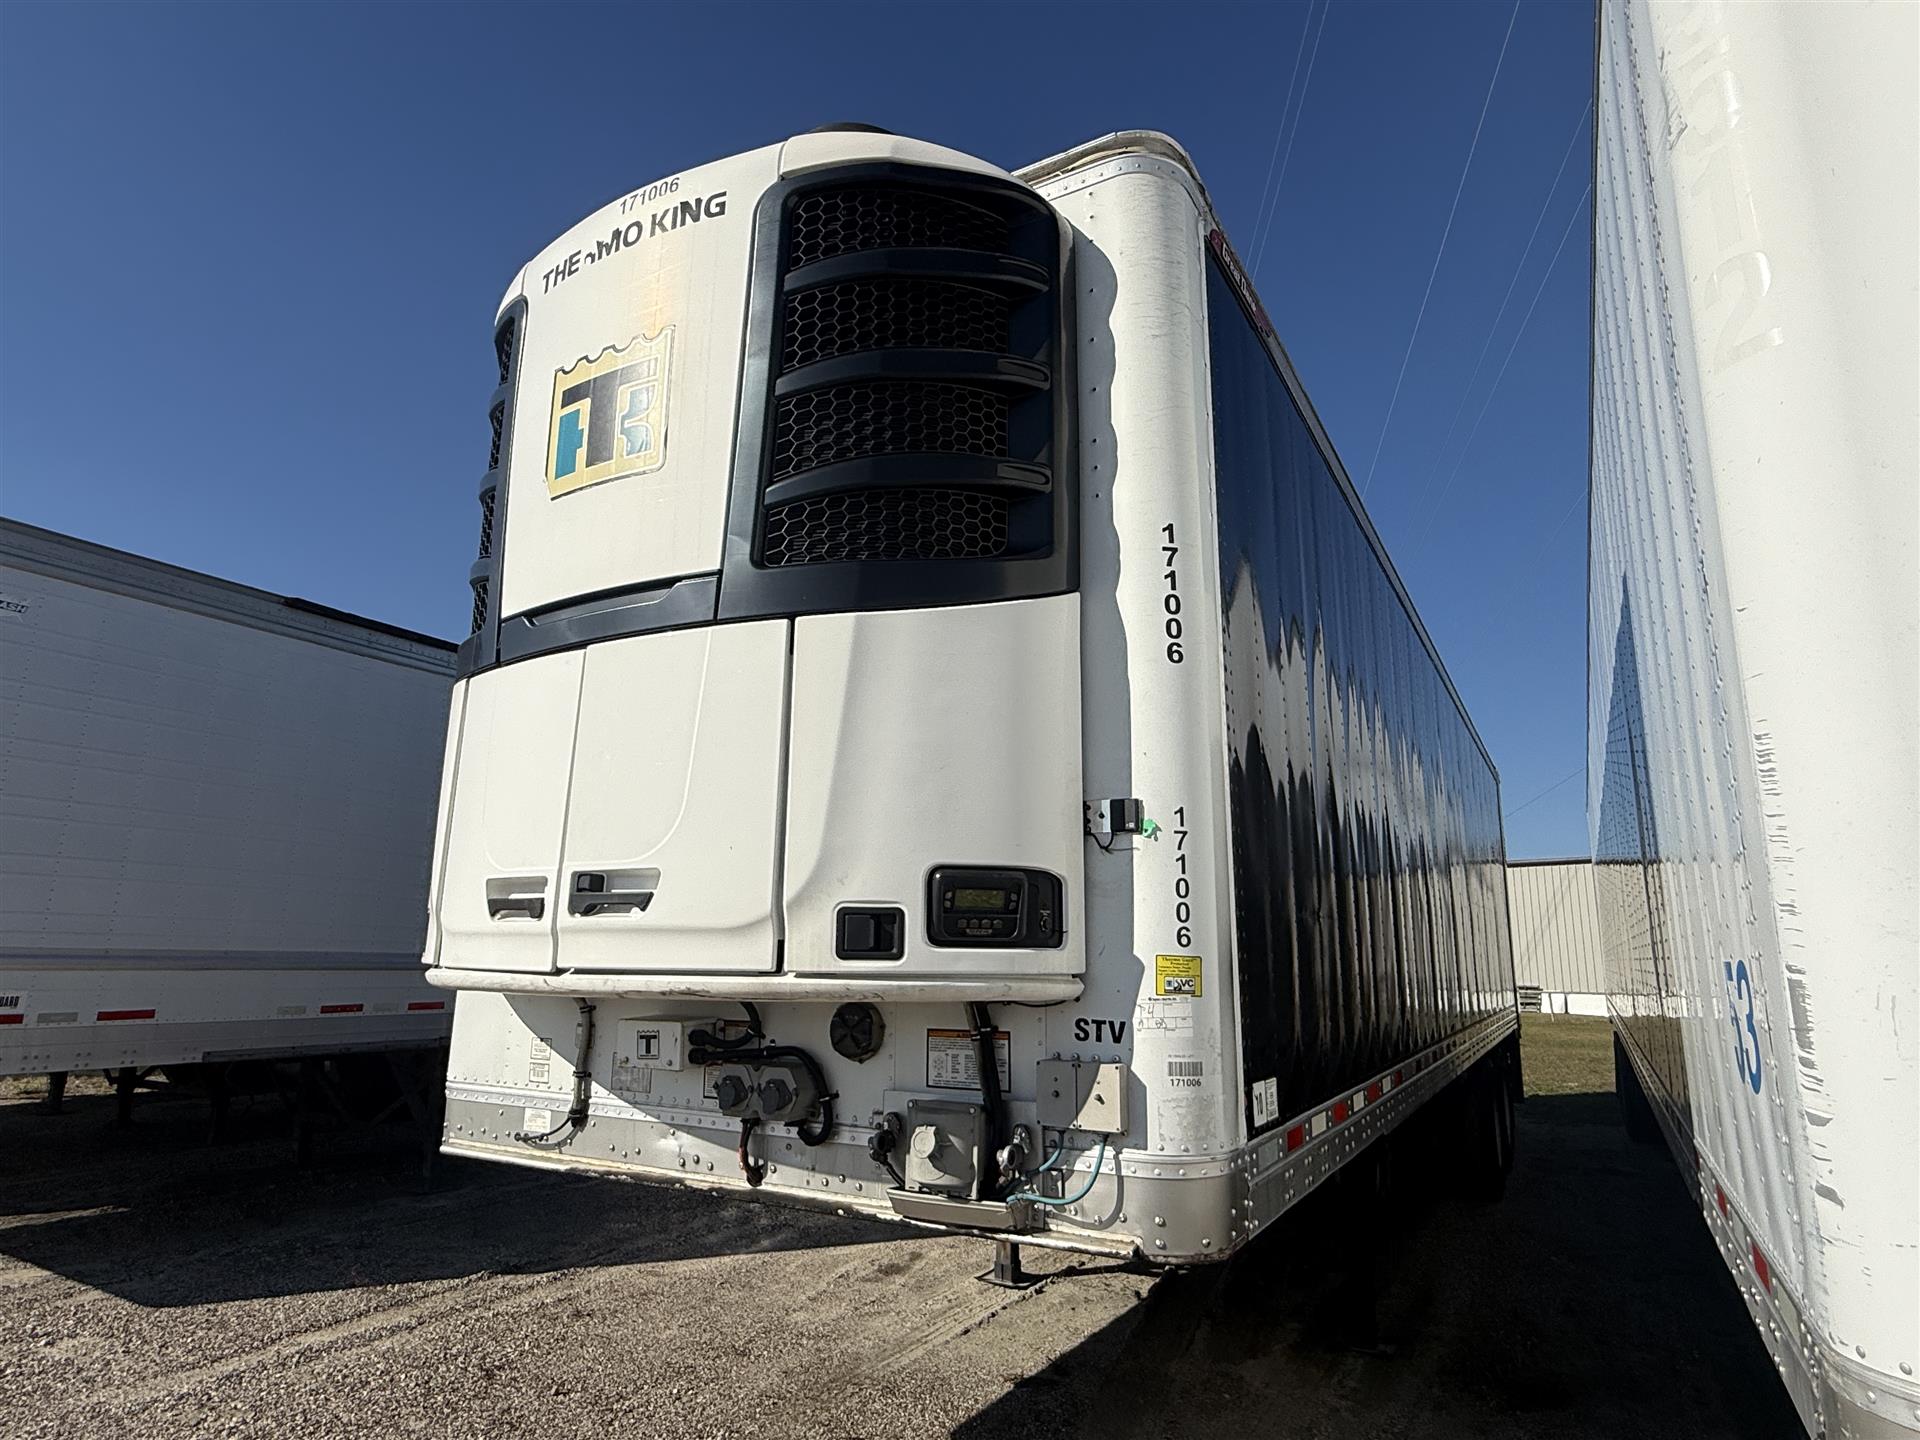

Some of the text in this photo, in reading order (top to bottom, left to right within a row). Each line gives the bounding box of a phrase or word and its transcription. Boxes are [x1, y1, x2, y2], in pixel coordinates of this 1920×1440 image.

[620, 177, 680, 215] 171006
[649, 190, 727, 238] KING
[1161, 522, 1184, 664] 171006
[1173, 806, 1192, 948] 171006
[1074, 1017, 1127, 1044] STV
[1170, 1078, 1202, 1087] 171006
